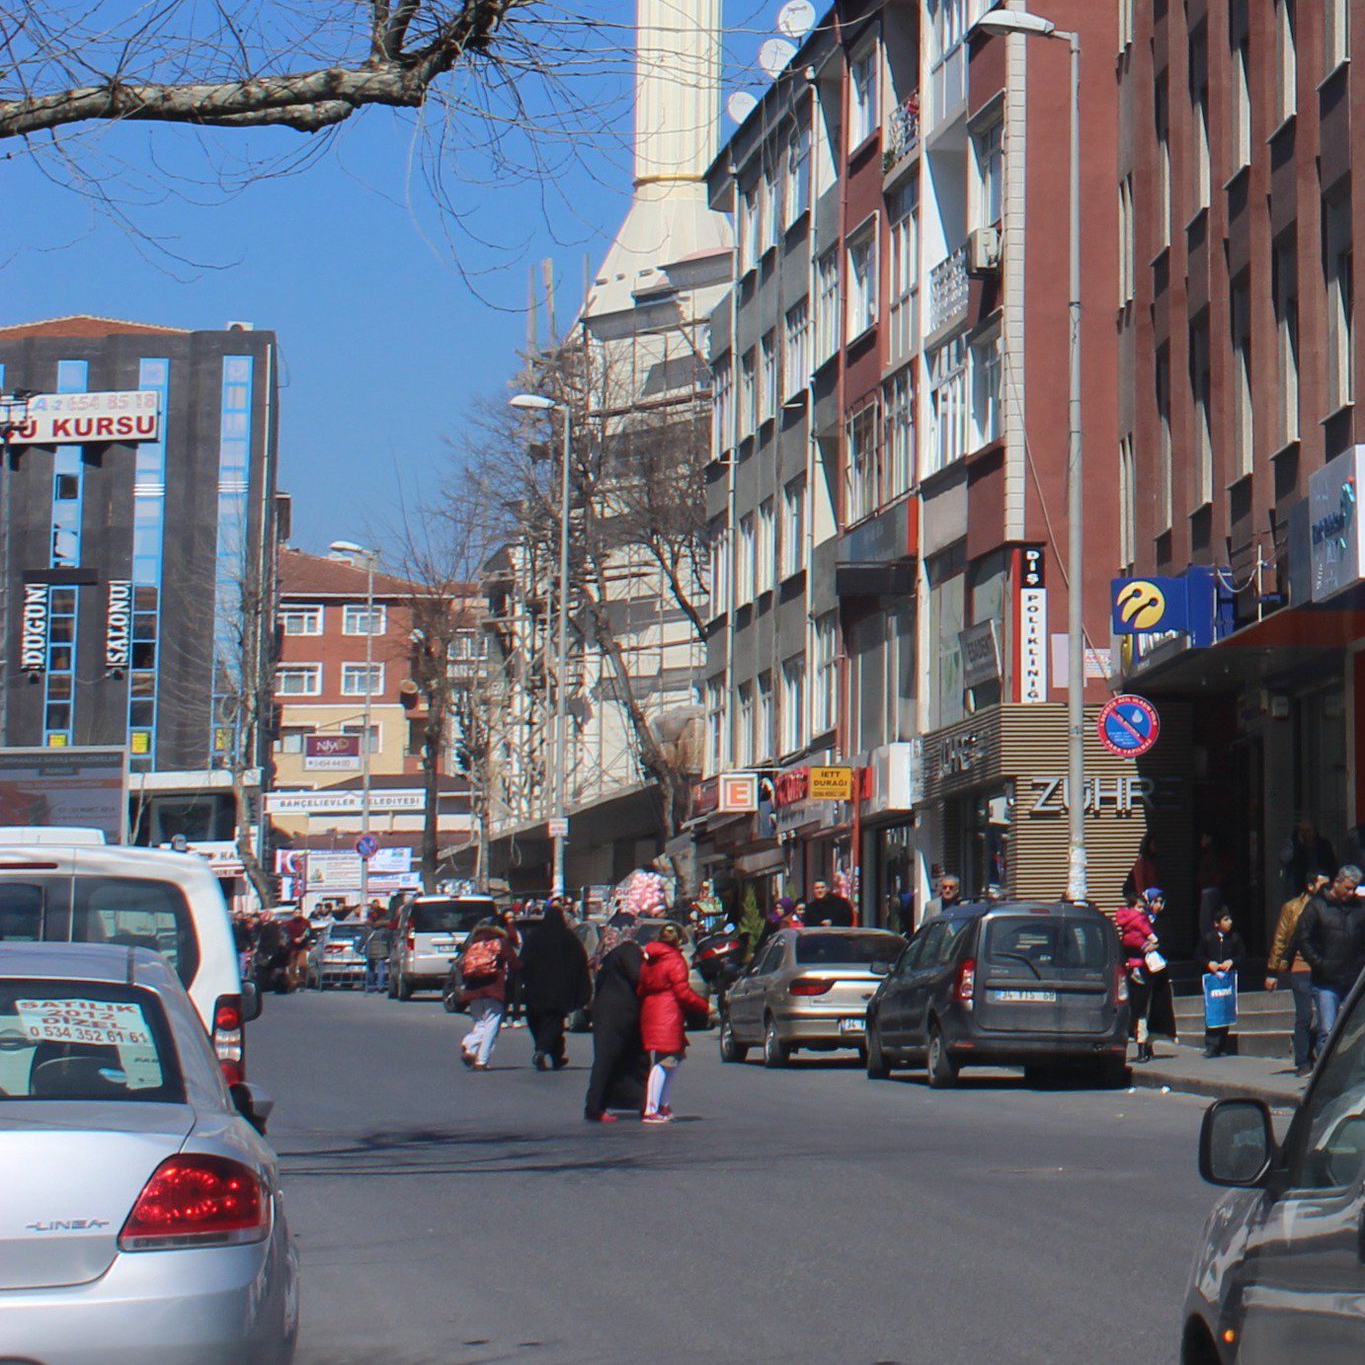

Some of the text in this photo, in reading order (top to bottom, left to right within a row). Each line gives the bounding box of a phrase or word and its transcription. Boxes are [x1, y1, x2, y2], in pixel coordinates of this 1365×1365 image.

[52, 416, 156, 438] KURSU
[1106, 739, 1122, 753] PARK
[21, 1001, 137, 1014] SATILIK
[47, 1009, 116, 1021] 2012
[30, 1026, 148, 1044] 0 534 352 61 61
[30, 1218, 106, 1232] LINEA
